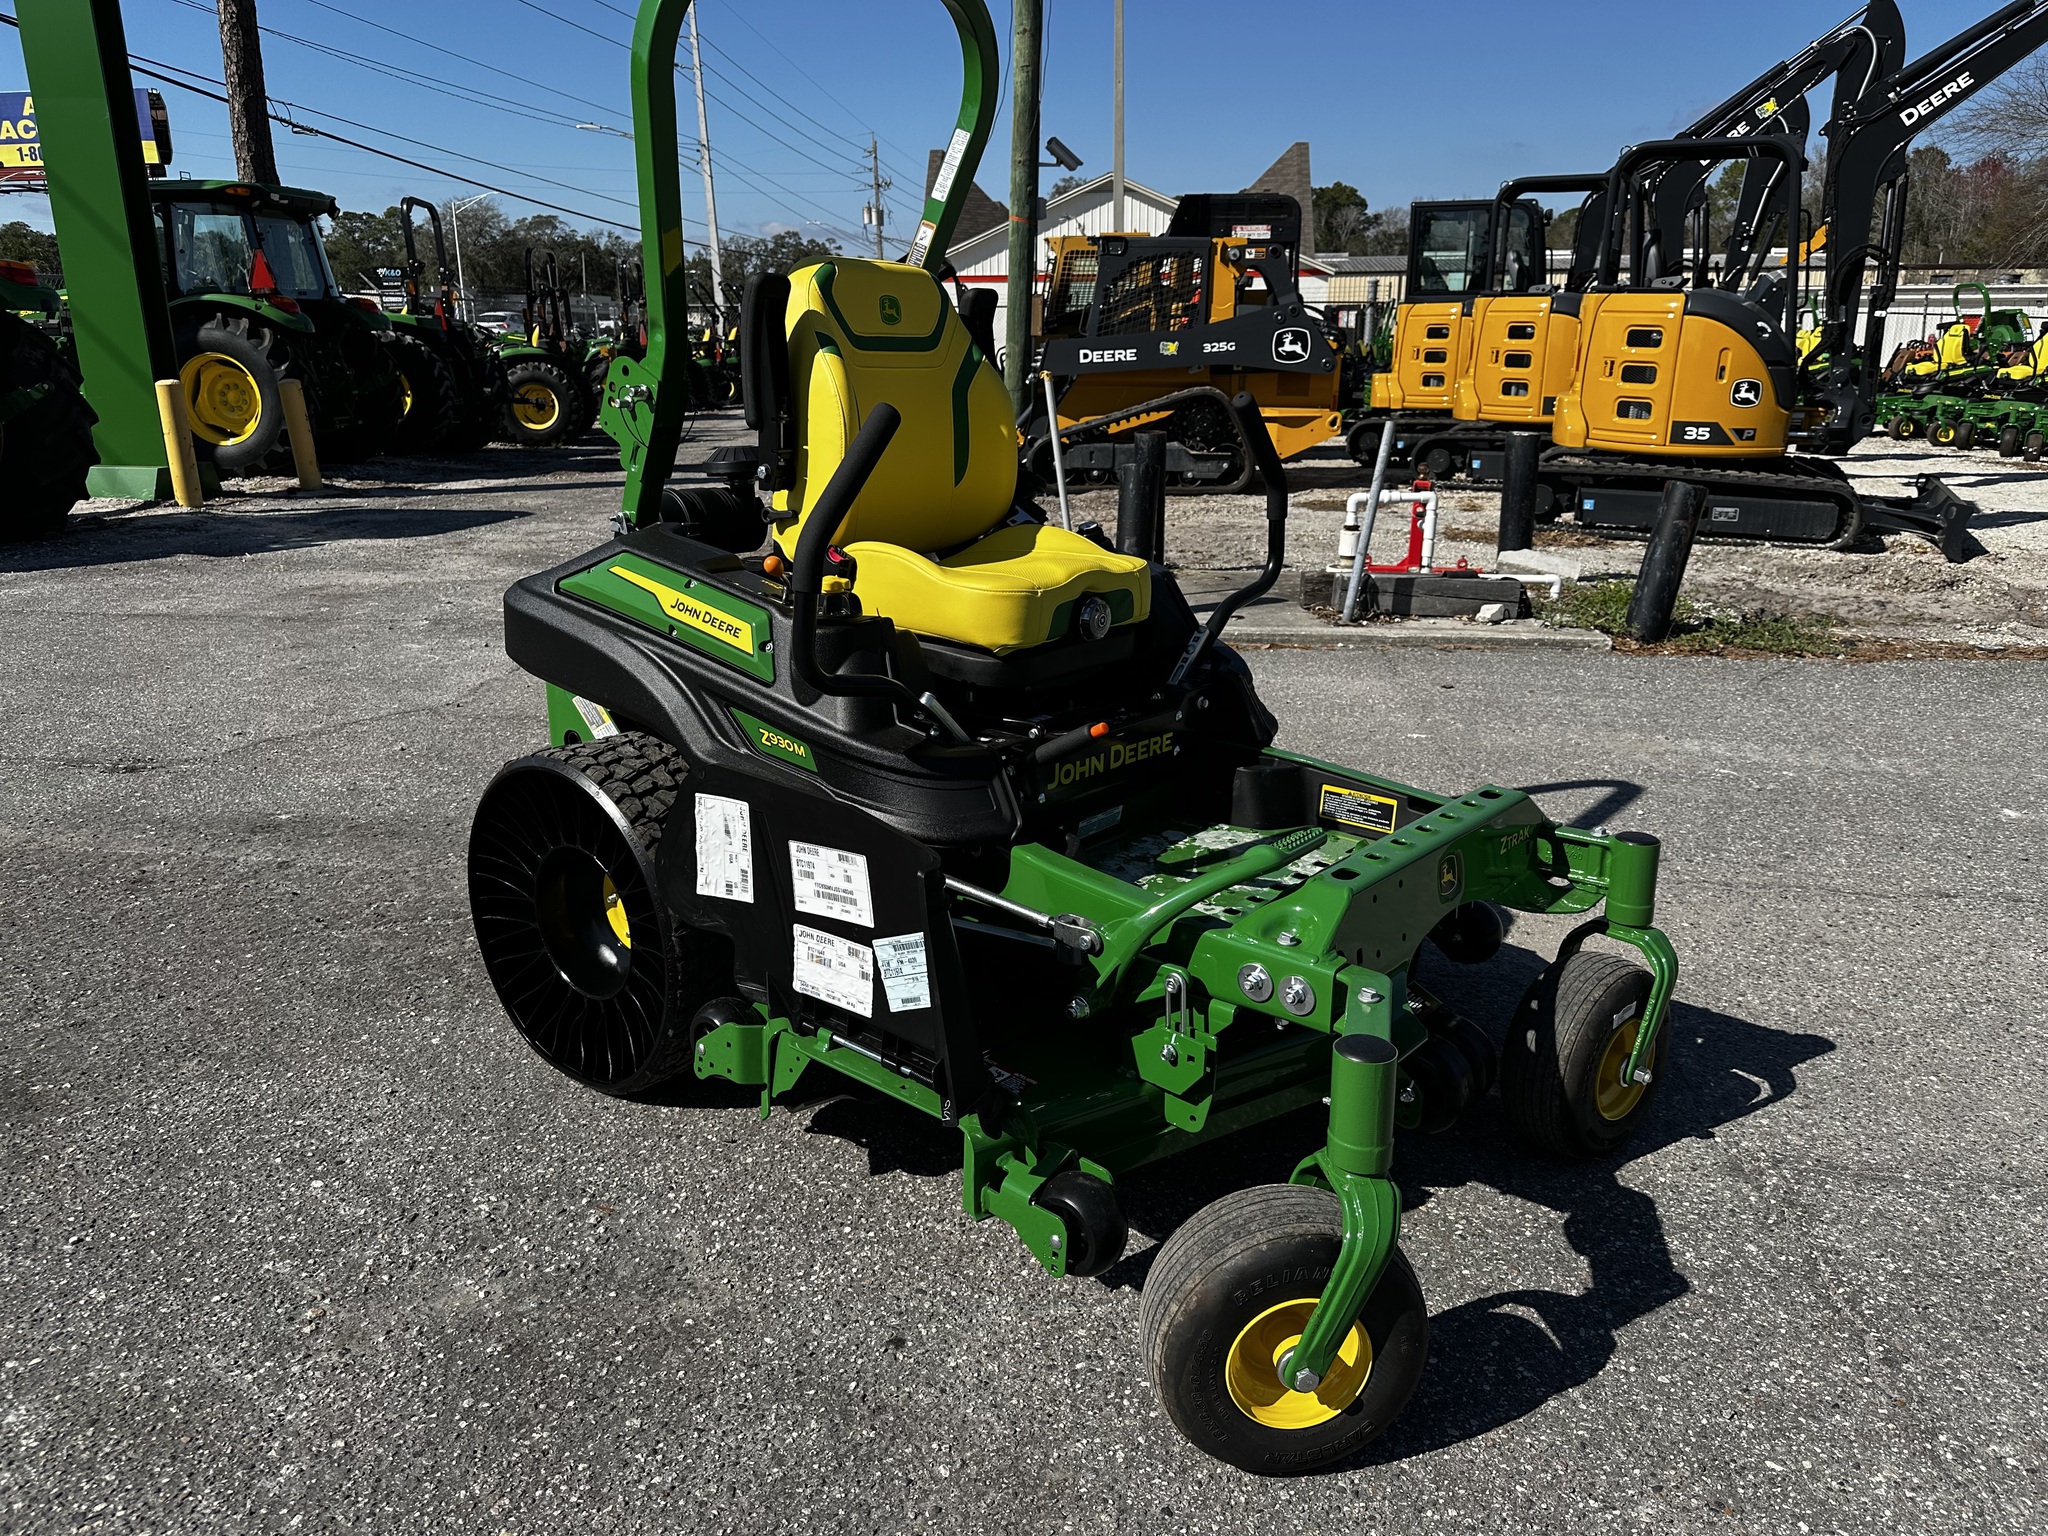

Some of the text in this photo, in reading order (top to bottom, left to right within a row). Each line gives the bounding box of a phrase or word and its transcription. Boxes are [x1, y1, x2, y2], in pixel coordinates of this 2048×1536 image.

[22, 97, 35, 116] A
[1899, 71, 1975, 127] DEERE
[0, 119, 39, 140] AC
[1079, 342, 1236, 364] DEERE 325G
[1683, 426, 1755, 441] 35 P
[670, 598, 742, 639] JOHN DEERE
[758, 728, 806, 758] Z930M
[1047, 732, 1174, 790] JOHN DEERE
[796, 845, 820, 858] JOHN DEERE
[1500, 825, 1530, 855] ZTRAK
[798, 930, 836, 948] JOHN DEERE
[1232, 1266, 1331, 1307] RELIAN
